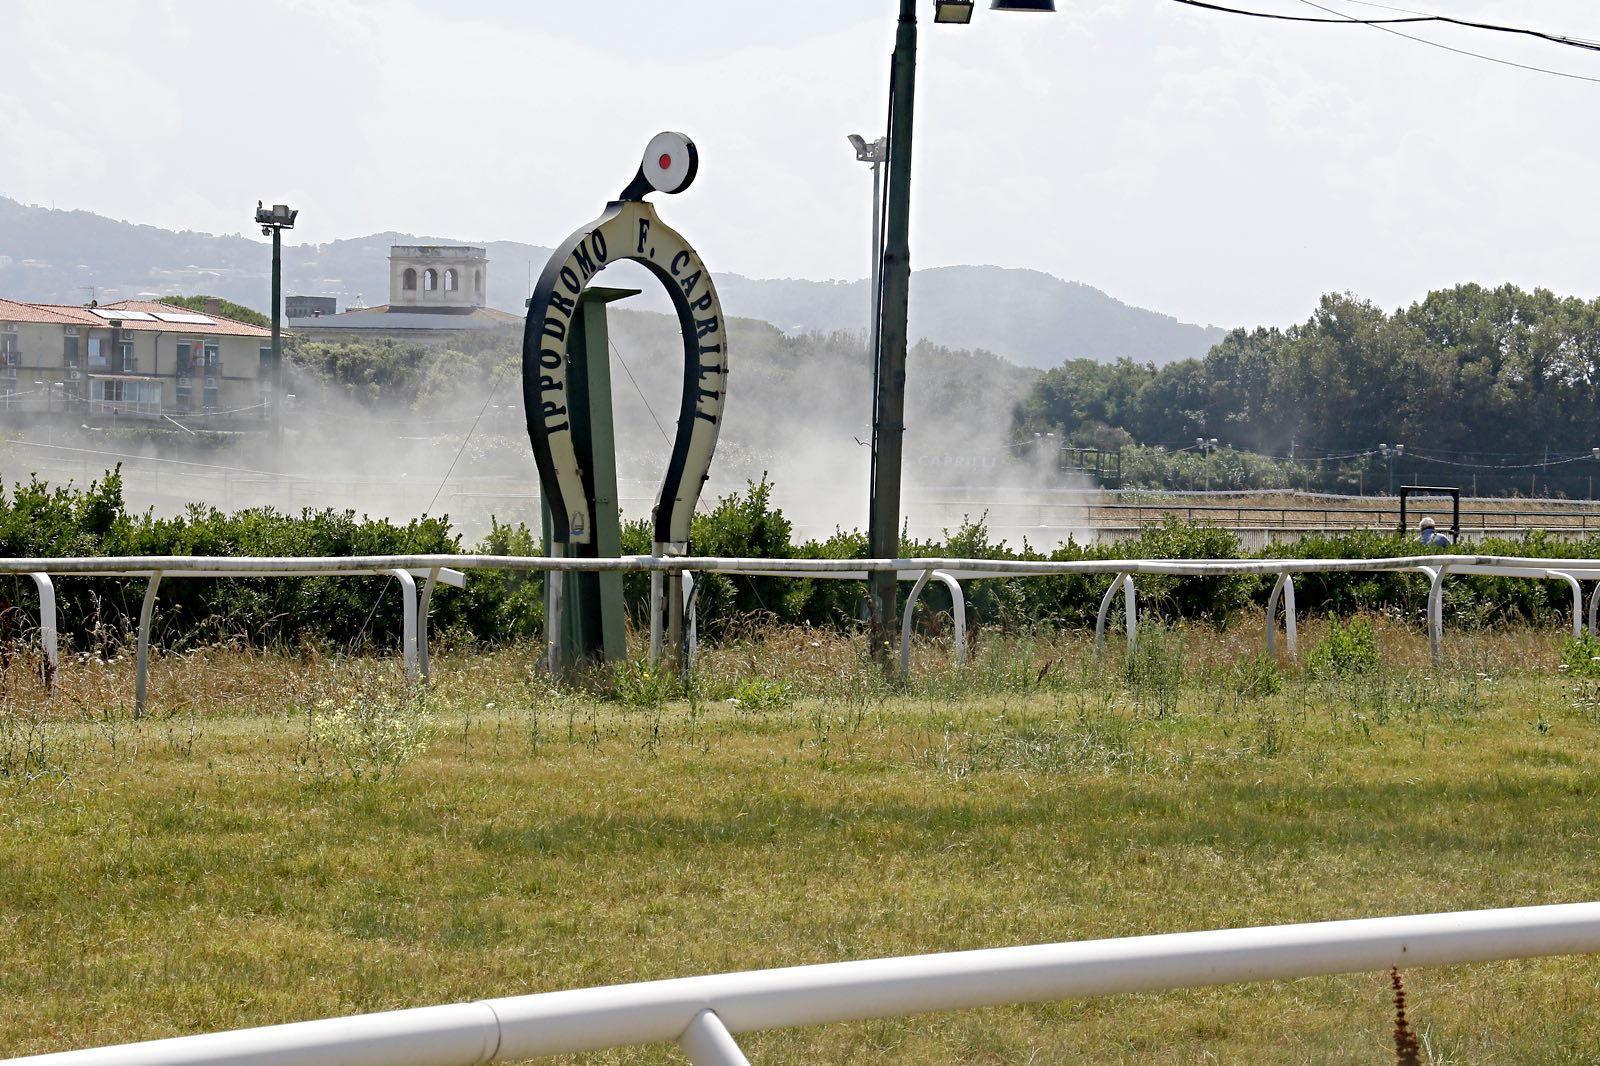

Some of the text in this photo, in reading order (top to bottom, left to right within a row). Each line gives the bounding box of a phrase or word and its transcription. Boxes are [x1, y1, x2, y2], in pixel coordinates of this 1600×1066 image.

[539, 217, 721, 435] IPPODROMO F. CAPRILLI
